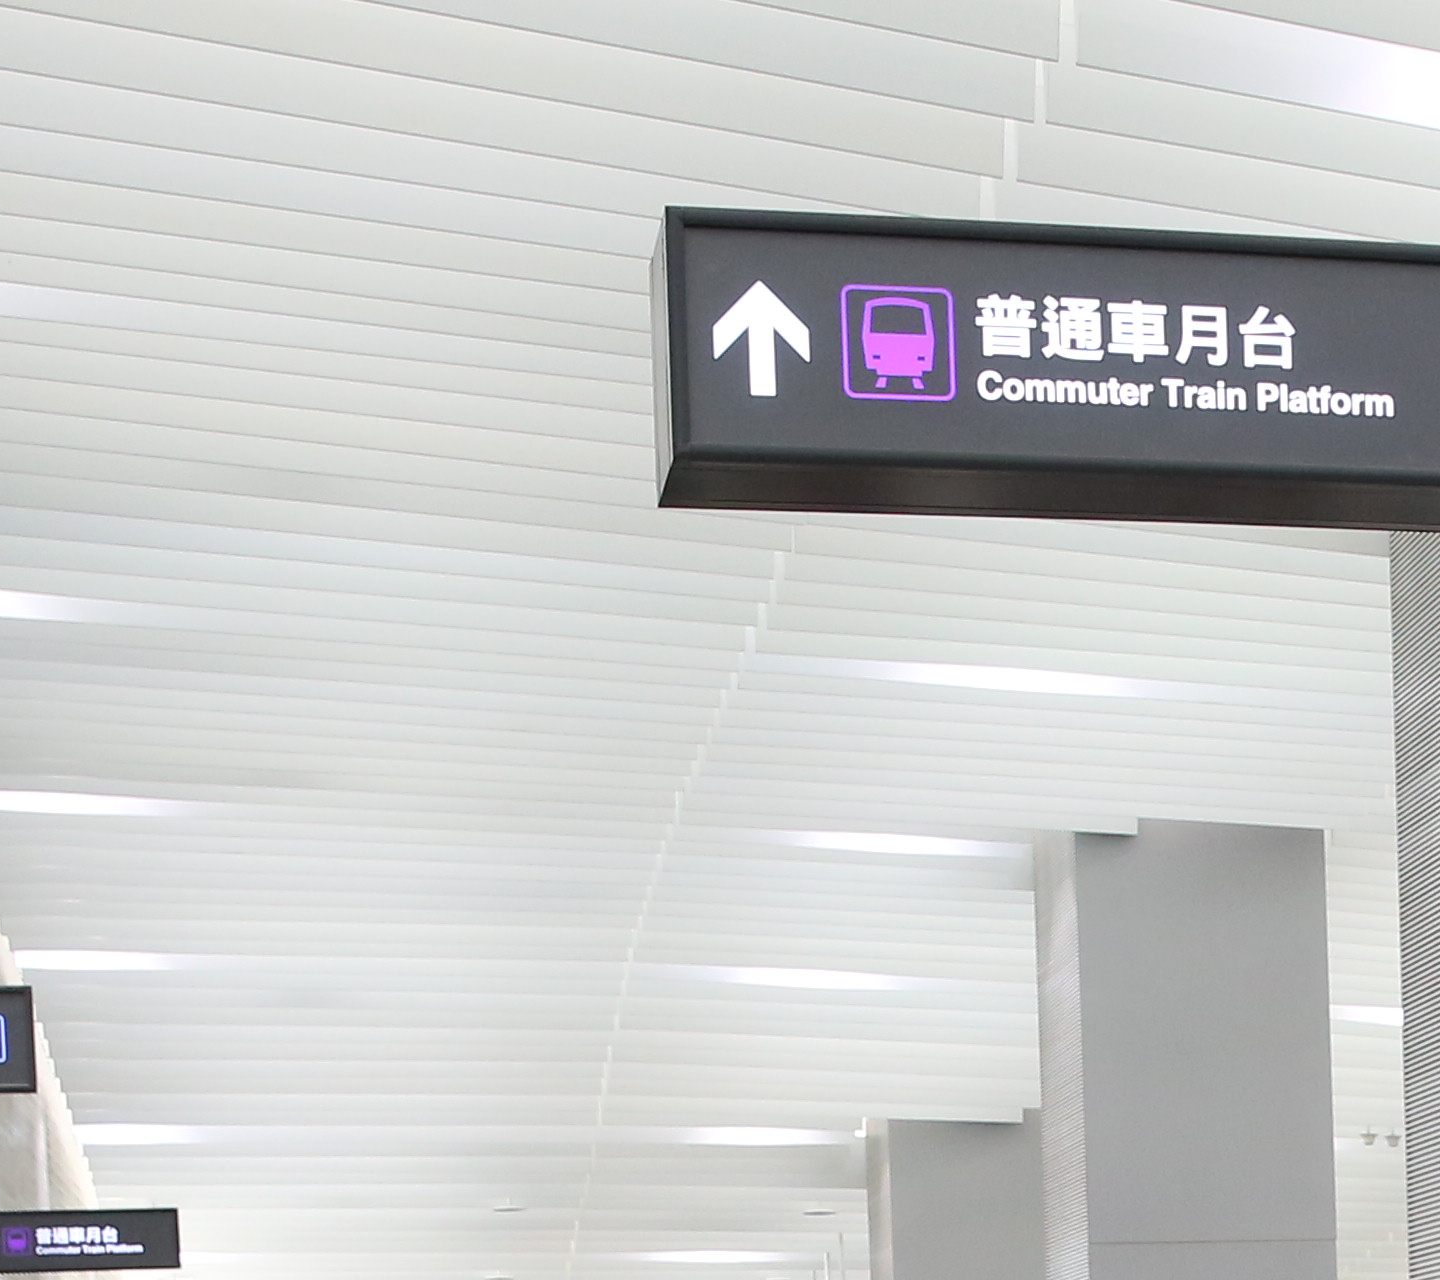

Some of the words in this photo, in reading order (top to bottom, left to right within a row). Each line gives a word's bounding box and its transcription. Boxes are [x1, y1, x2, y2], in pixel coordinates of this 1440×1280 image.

[975, 294, 1296, 371] 普通車月台
[976, 371, 1153, 410] Commuter
[1160, 378, 1247, 412] Train
[1257, 381, 1395, 418] Platform
